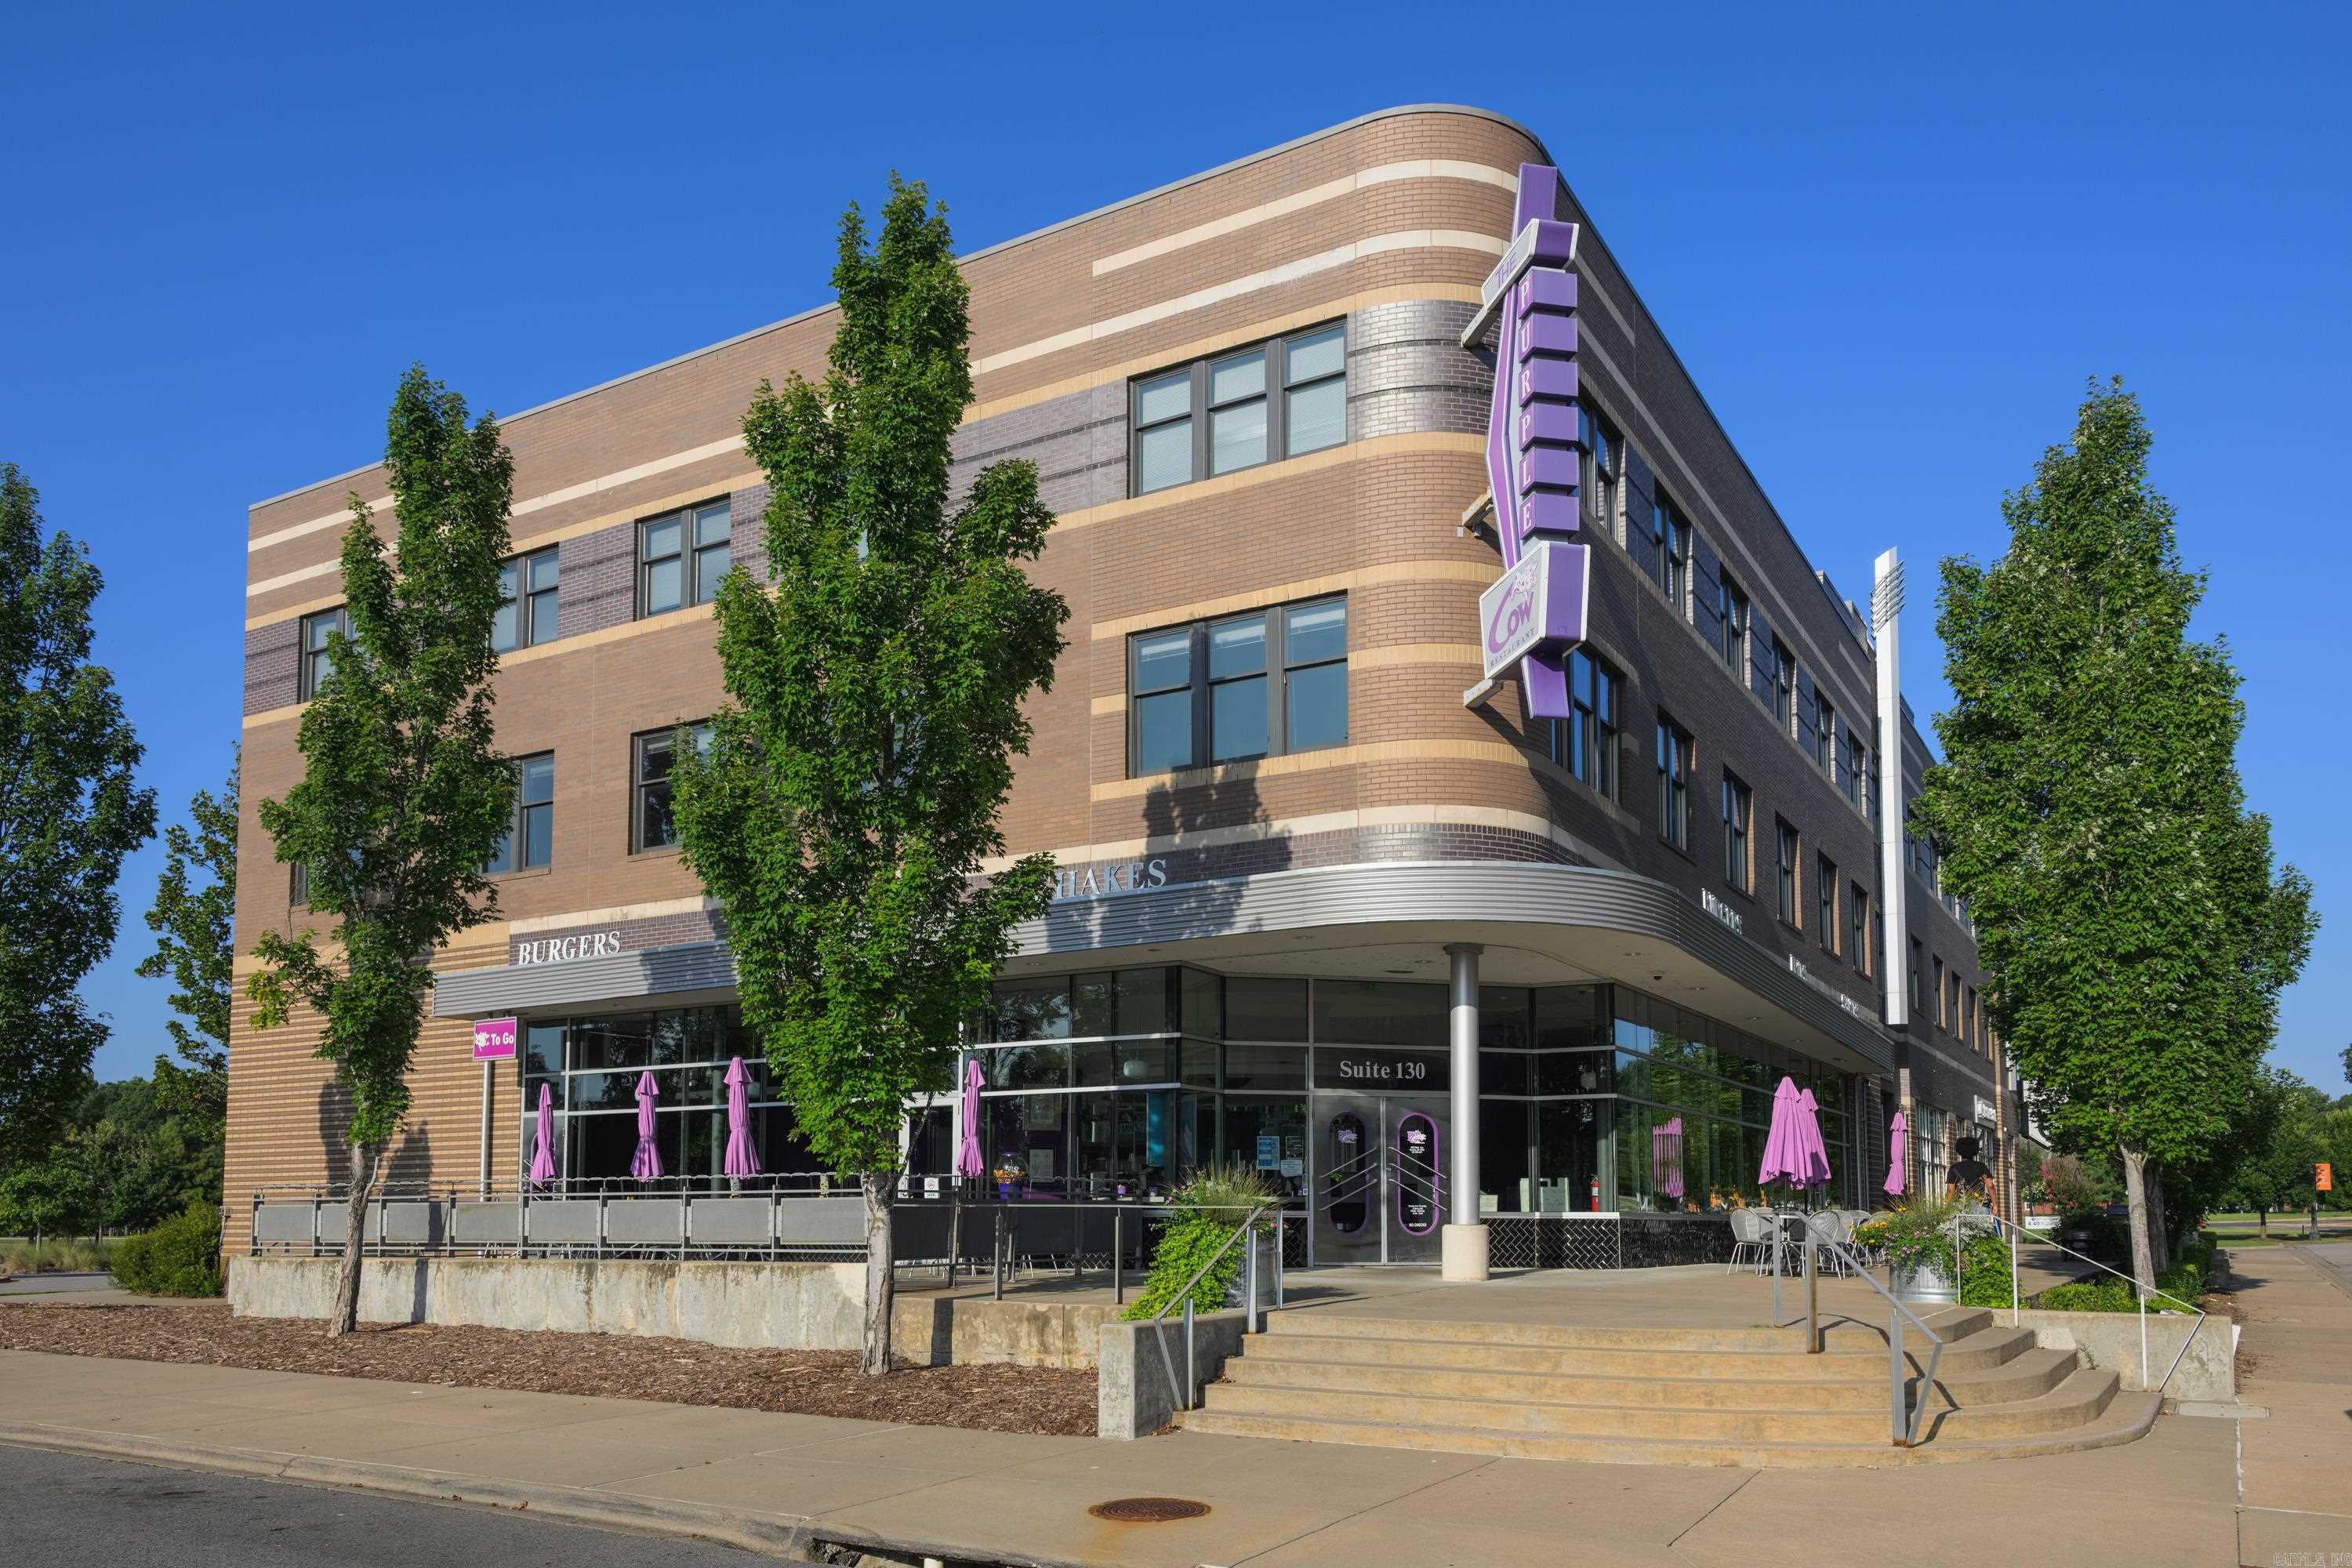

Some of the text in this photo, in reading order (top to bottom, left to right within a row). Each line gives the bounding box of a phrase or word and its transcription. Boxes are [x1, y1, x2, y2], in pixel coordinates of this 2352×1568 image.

[1496, 251, 1517, 288] THE
[1520, 279, 1533, 532] PURPLE
[1490, 627, 1536, 667] RESTAURANT
[1055, 860, 1167, 898] HAKES
[518, 931, 620, 965] BURGERS
[491, 1032, 514, 1046] To Go
[1340, 1061, 1425, 1079] Suite 130
